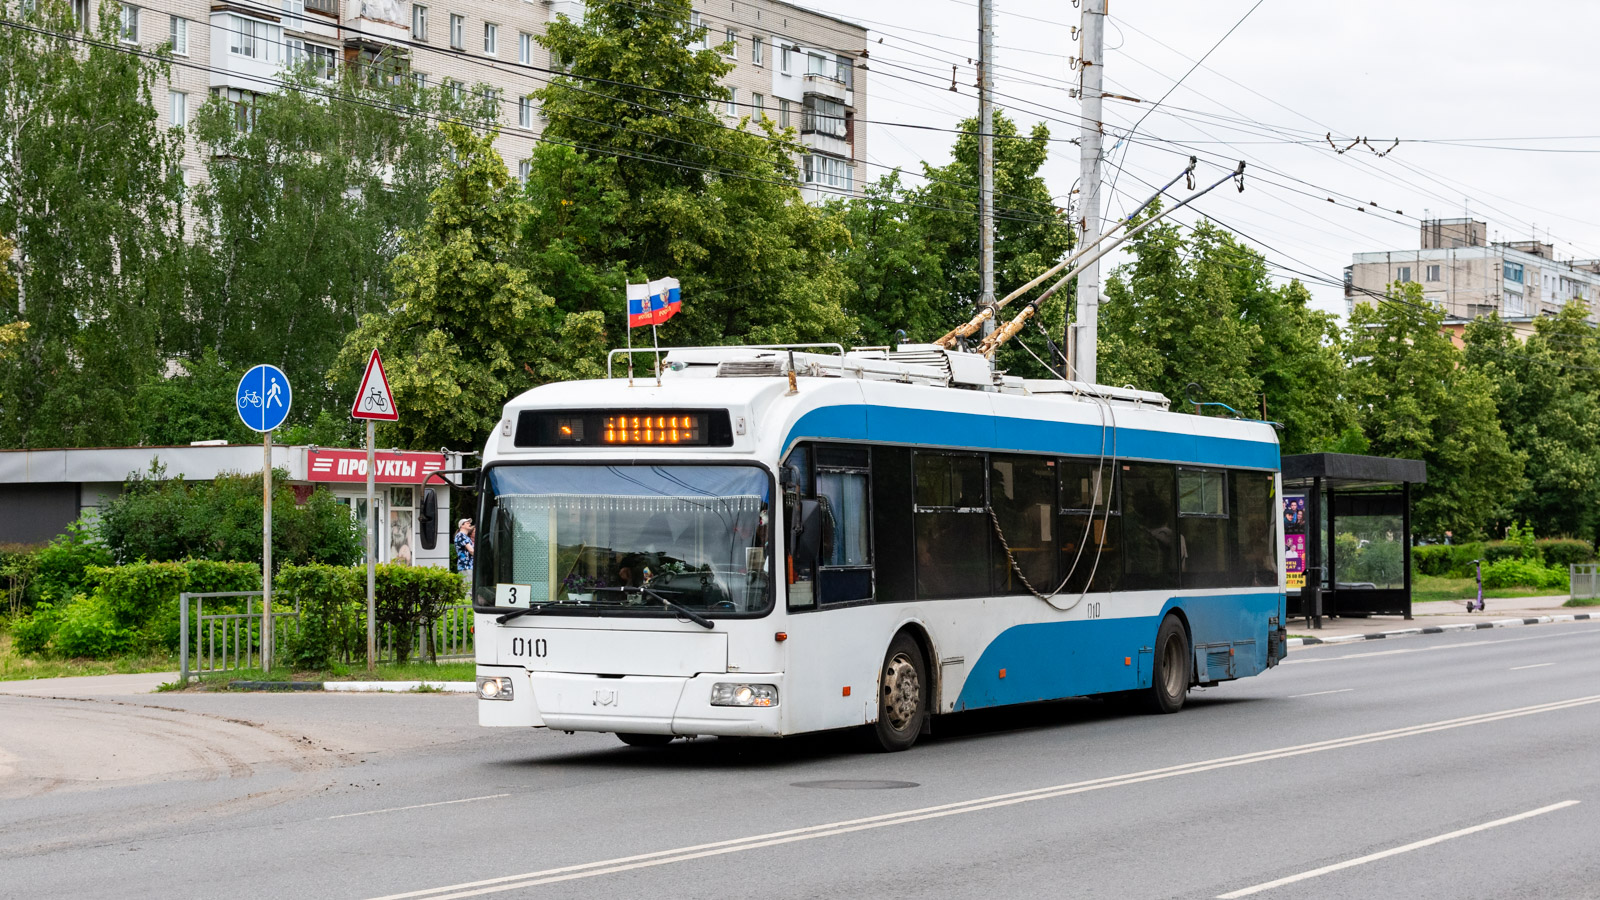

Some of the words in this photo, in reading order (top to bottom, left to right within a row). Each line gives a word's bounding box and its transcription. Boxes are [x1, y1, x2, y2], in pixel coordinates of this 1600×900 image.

[337, 458, 417, 477] ПРОУКТЫ
[508, 587, 517, 604] 3
[1087, 602, 1101, 619] 010
[512, 637, 547, 657] 010
